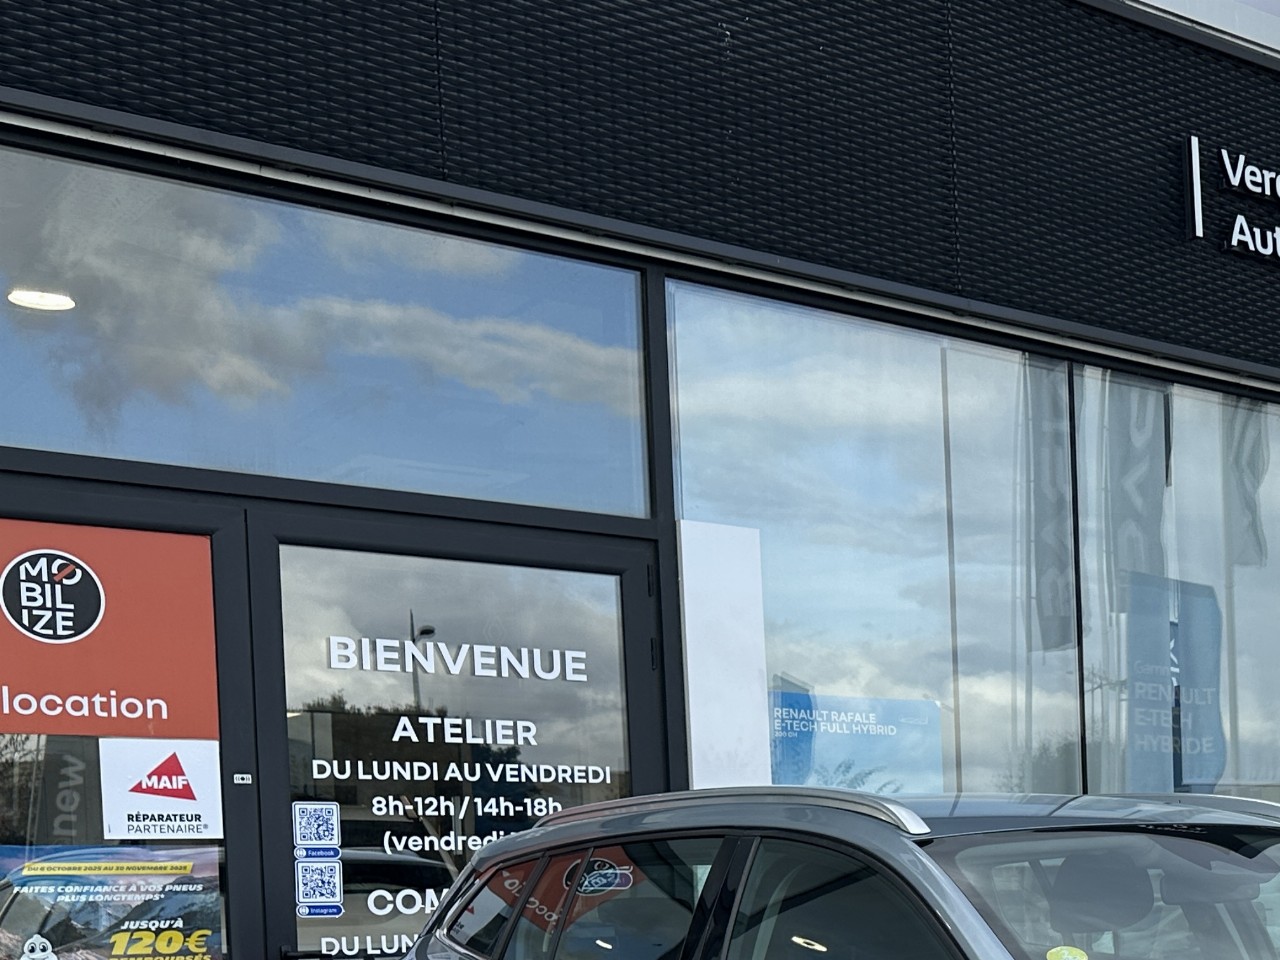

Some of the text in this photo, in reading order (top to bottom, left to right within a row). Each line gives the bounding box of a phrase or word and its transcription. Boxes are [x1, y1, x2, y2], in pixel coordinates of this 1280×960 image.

[19, 582, 75, 609] BIL
[21, 608, 75, 635] IZE
[328, 635, 588, 682] BIENVENUE
[1, 685, 168, 719] location
[1134, 682, 1216, 705] RENULT
[774, 707, 877, 724] RENAULT RAFALE
[392, 716, 538, 746] ATELIER
[774, 719, 897, 736] E-TECH FULL HYBRID
[312, 759, 611, 784] DU LUNDI AU VENDREDI
[141, 775, 189, 790] MAIF
[371, 796, 454, 816] 8h-12h
[475, 797, 562, 816] 14h-18h
[127, 811, 202, 822] RÉPARATEUR
[13, 885, 55, 893] FAITES
[57, 884, 128, 892] CONFIANCE
[128, 883, 138, 892] À
[165, 884, 204, 892] PNEUS
[56, 894, 86, 902] PLUS
[310, 907, 338, 915] Instagram
[110, 929, 212, 955] 120€
[320, 937, 359, 956] DU
